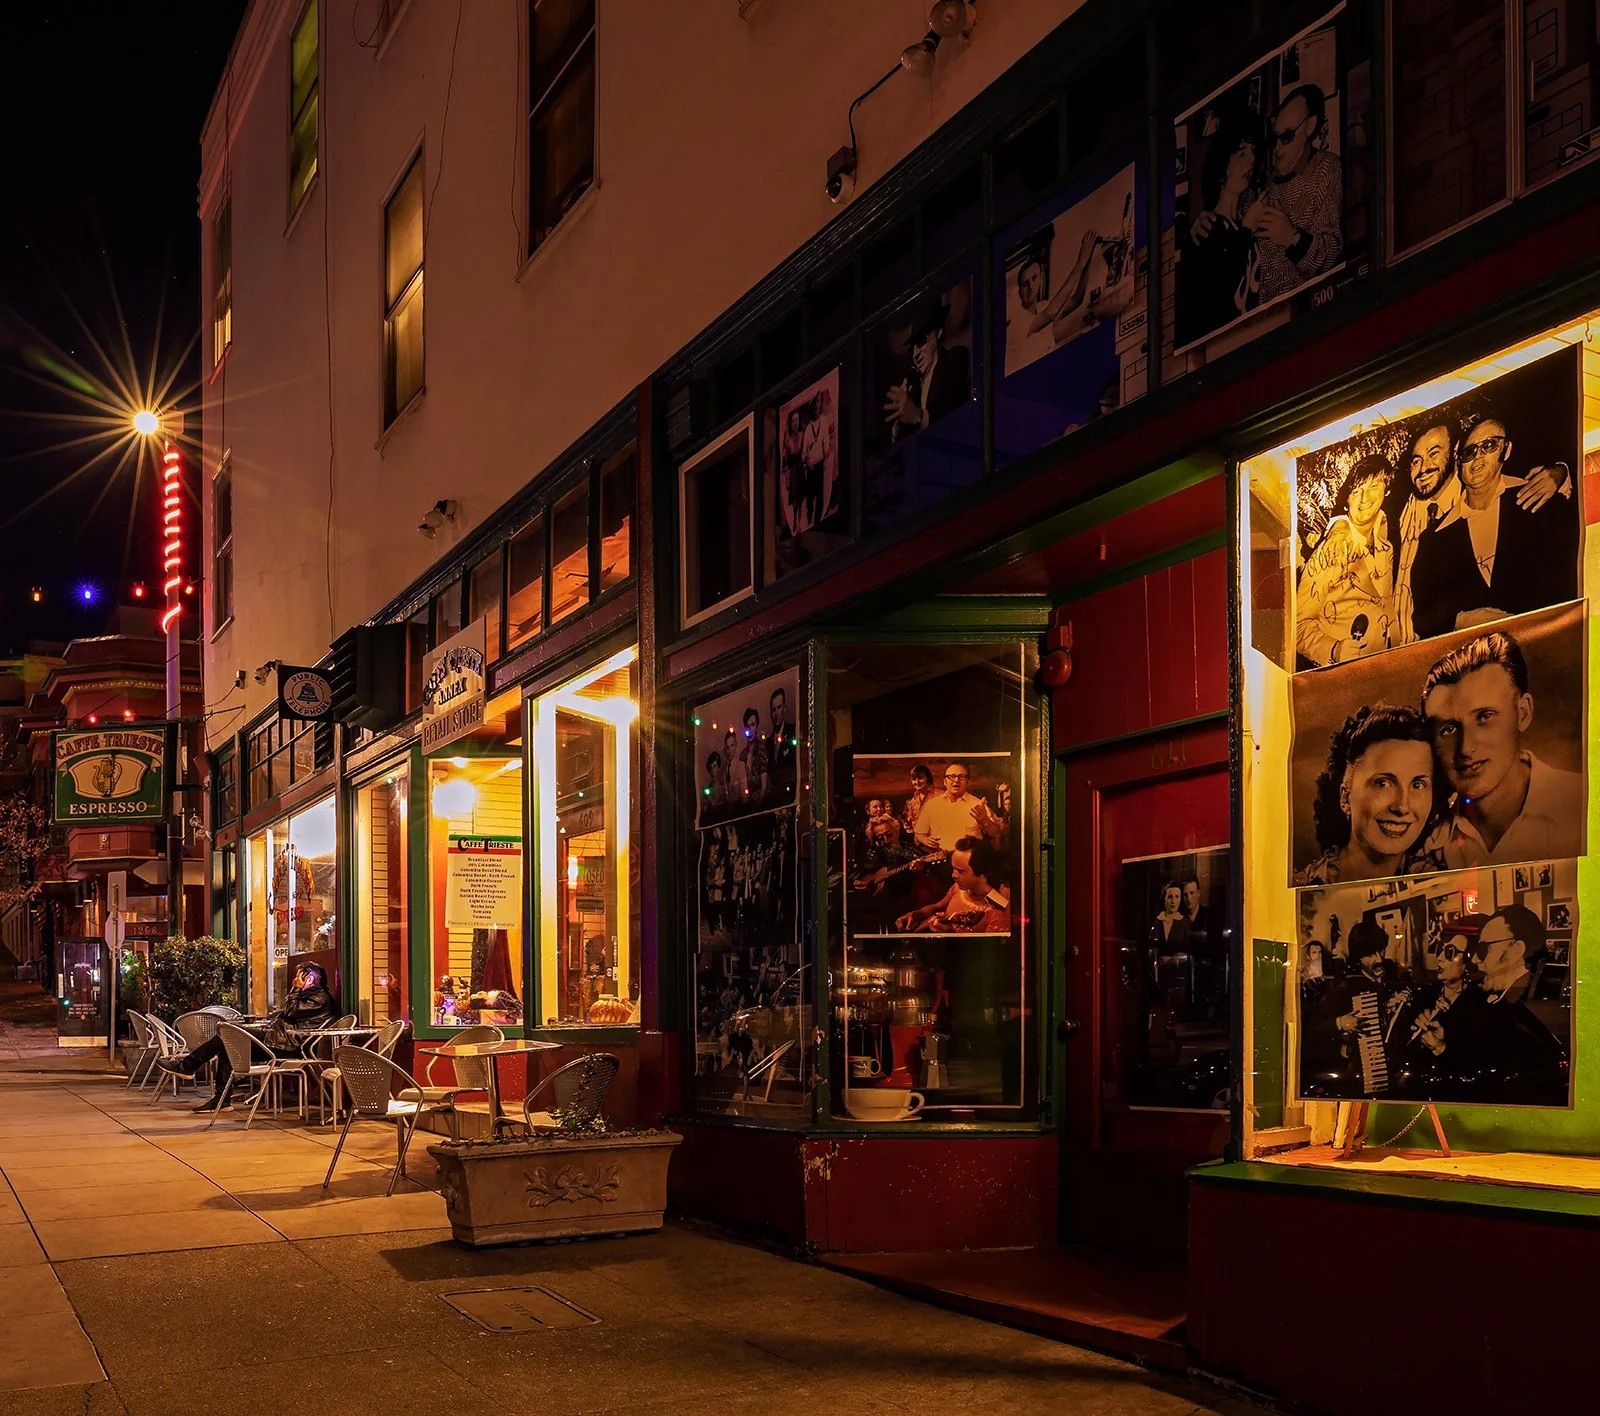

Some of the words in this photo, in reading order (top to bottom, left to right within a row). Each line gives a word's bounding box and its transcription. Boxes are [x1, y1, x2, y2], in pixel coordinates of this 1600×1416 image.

[291, 673, 325, 686] PUBLIC
[438, 677, 467, 705] ANNEX
[286, 696, 330, 715] TELEPHONE
[424, 714, 451, 747] RETAIL
[453, 698, 482, 733] STORE
[56, 734, 100, 759] CAFFE
[104, 733, 164, 756] TRIESTE
[69, 801, 148, 815] ESPRESSO
[458, 836, 482, 852] CAFFE
[480, 837, 514, 852] TRIESTE
[134, 926, 157, 936] 1268
